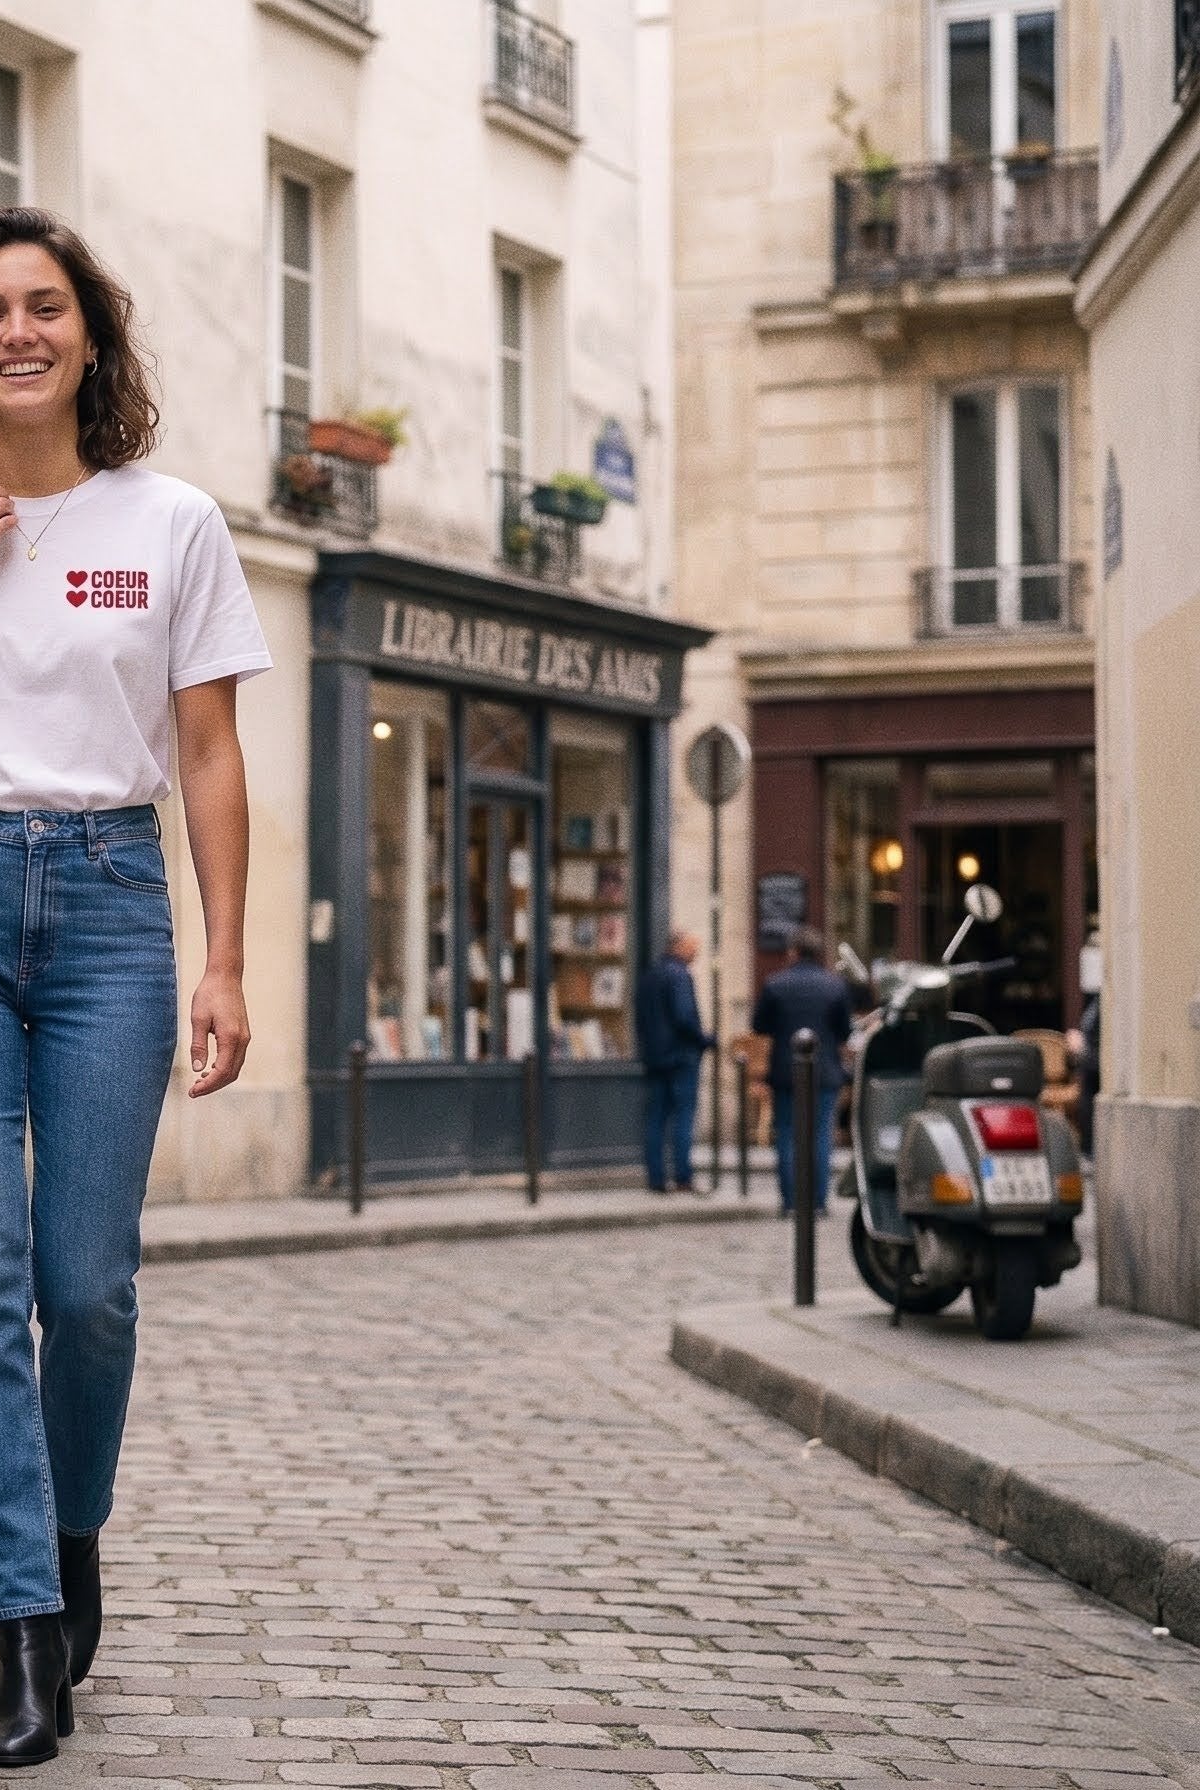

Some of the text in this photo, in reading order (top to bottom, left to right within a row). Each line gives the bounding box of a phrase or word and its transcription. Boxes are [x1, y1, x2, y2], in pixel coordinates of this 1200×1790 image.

[91, 570, 148, 589] COEUR
[91, 590, 148, 609] COEUR
[380, 600, 534, 682] LIBRAIRIE
[535, 630, 594, 691] DES
